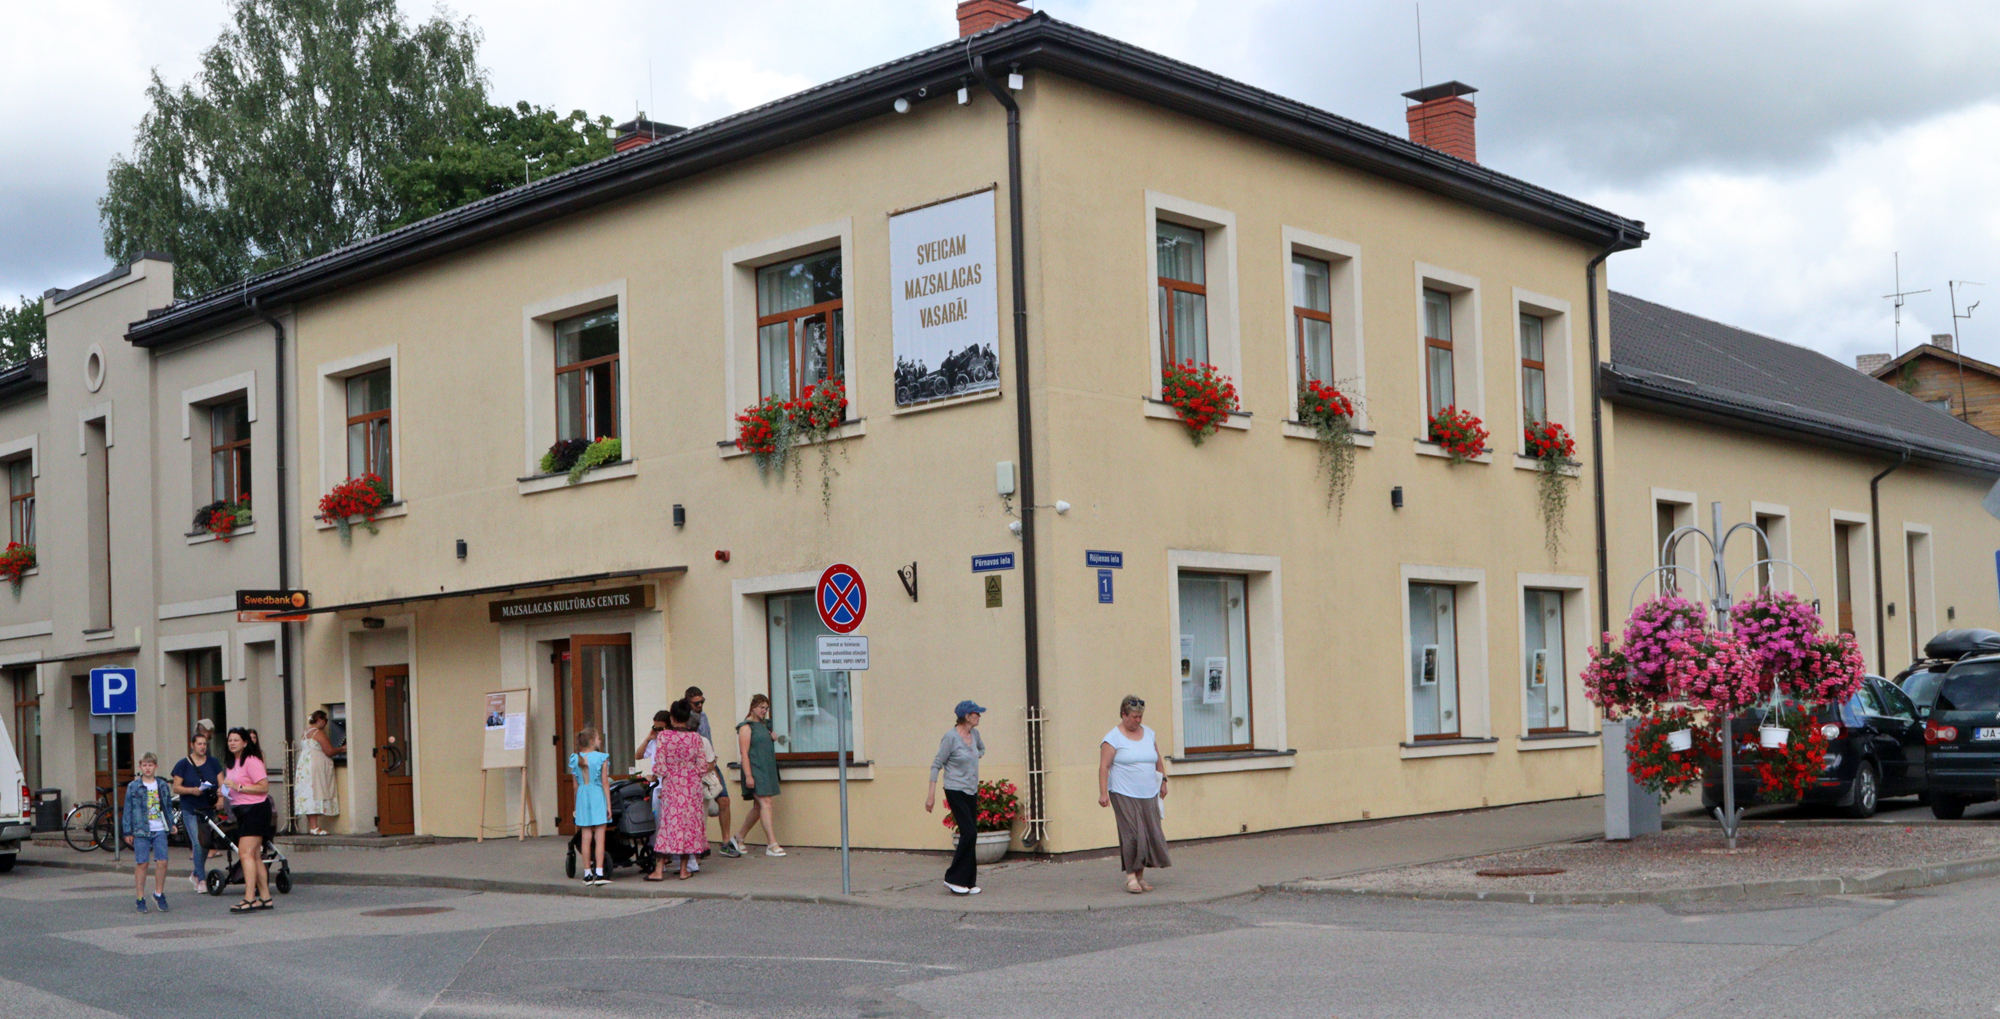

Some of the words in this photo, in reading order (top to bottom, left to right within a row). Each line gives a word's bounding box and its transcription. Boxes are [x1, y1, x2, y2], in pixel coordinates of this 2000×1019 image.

[917, 234, 966, 265] SVEICAM
[905, 263, 981, 300] MAZSALACAS
[920, 297, 967, 328] VASARĀ!
[975, 558, 999, 567] Pērnavas
[1000, 556, 1010, 564] iela
[1090, 553, 1110, 563] Rūjienas
[1110, 554, 1119, 563] iela
[1102, 578, 1108, 592] 1
[244, 595, 291, 604] Swedbank
[502, 602, 552, 617] MAZSALACAS
[553, 597, 596, 612] KULTŪRAS
[597, 593, 630, 608] CENTRS
[103, 673, 128, 708] P
